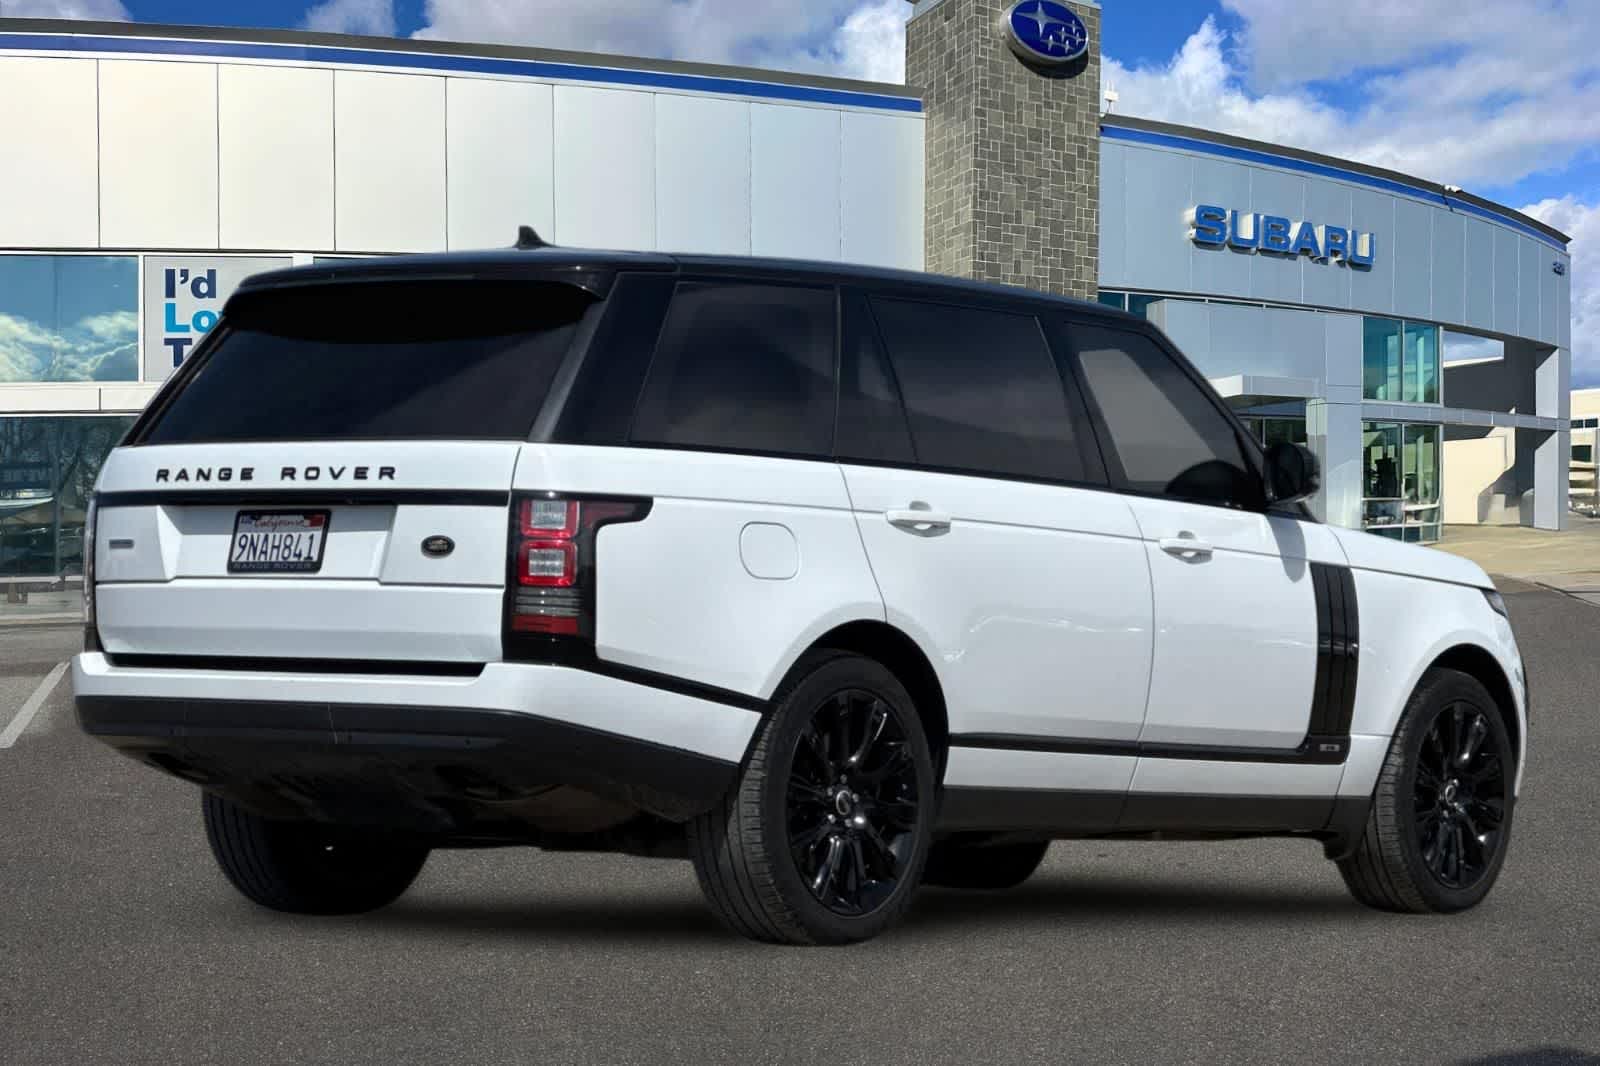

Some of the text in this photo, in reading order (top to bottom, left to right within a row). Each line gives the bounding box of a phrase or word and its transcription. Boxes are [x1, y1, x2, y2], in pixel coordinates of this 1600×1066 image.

[1194, 204, 1376, 266] SUBARU
[165, 268, 217, 299] I’d
[165, 303, 224, 333] Lo
[163, 338, 193, 368] T
[156, 466, 396, 482] RANGE ROVER
[235, 533, 314, 561] 9NAH841
